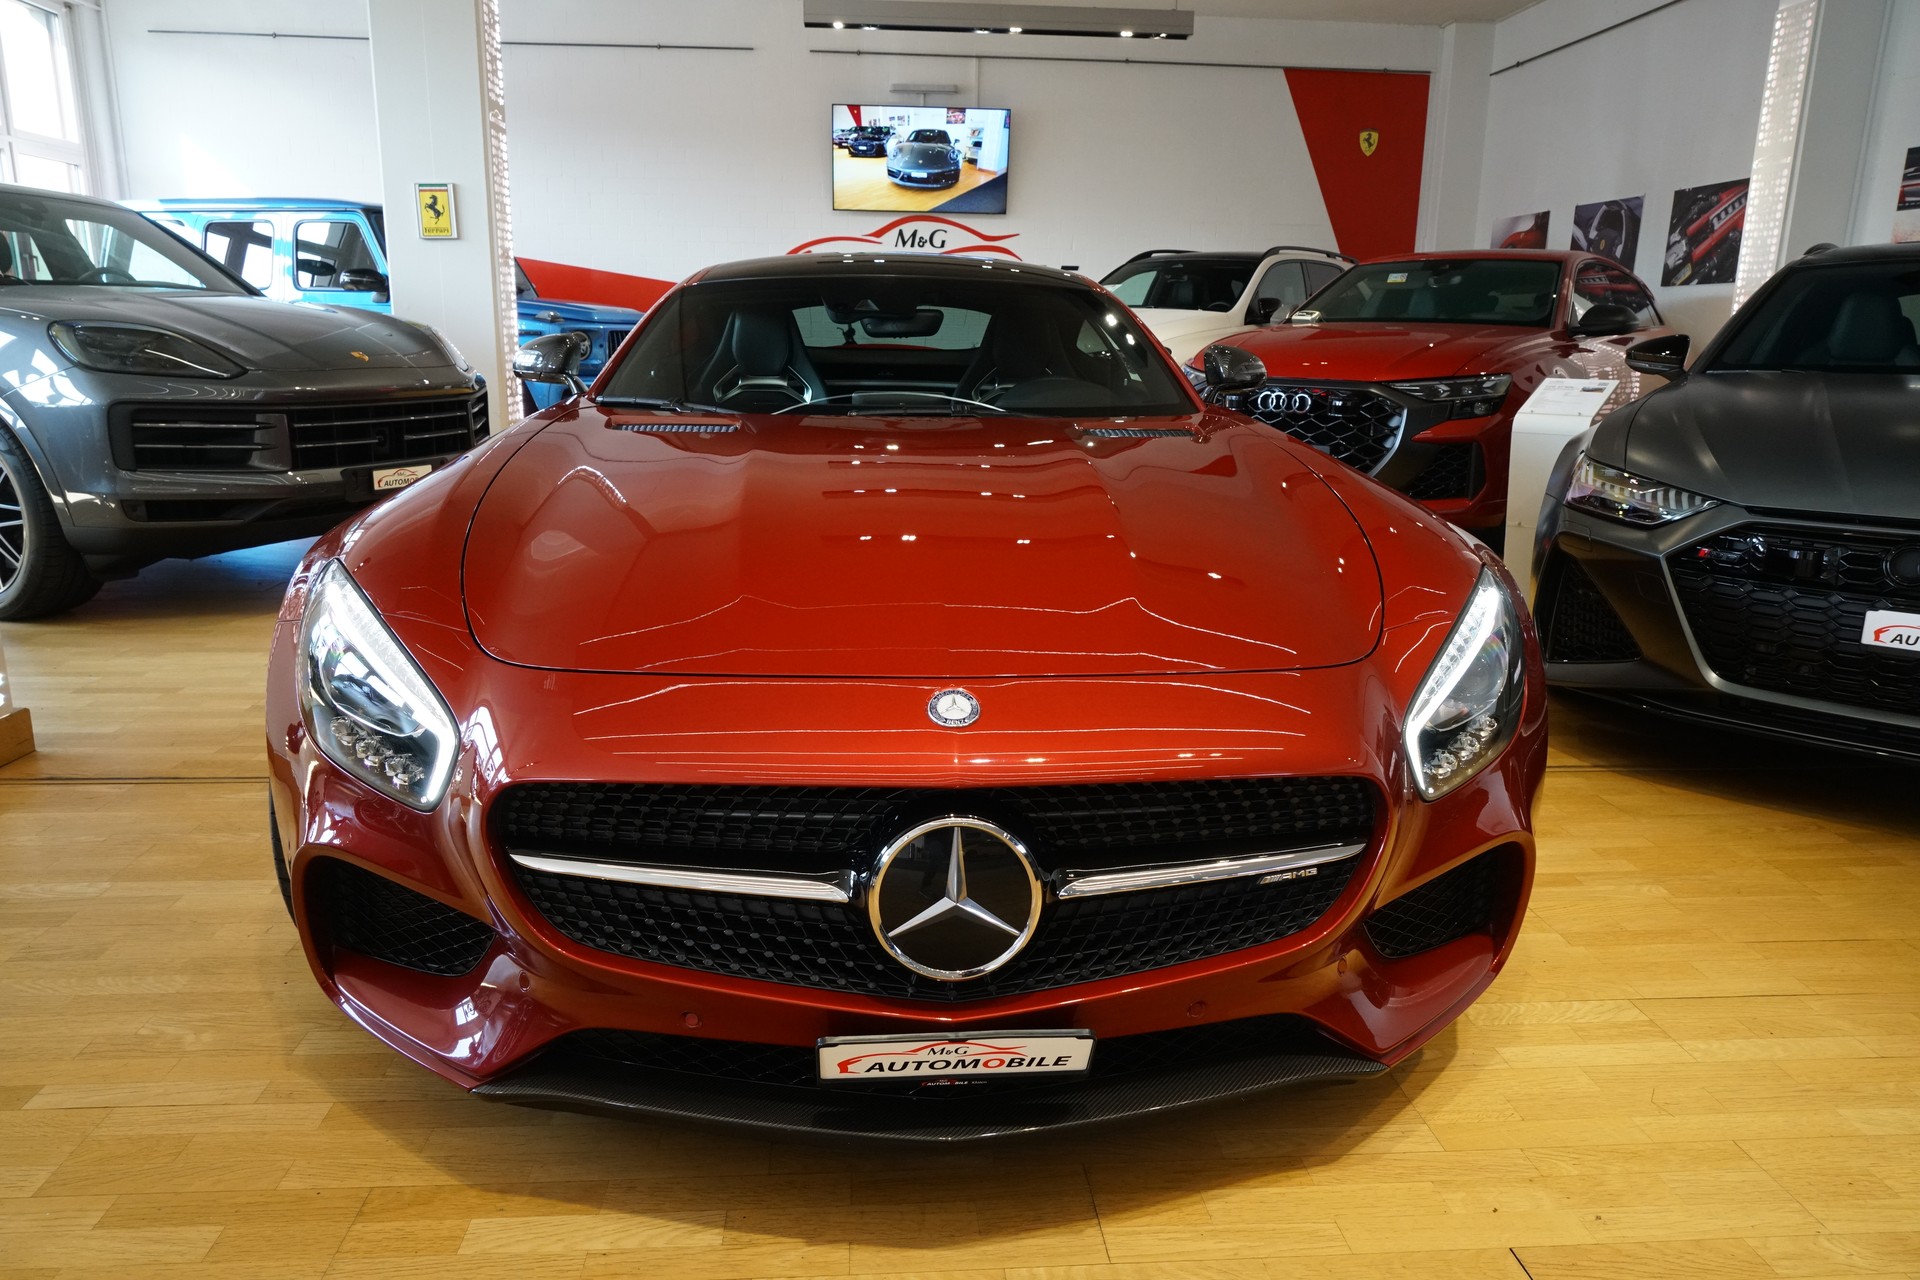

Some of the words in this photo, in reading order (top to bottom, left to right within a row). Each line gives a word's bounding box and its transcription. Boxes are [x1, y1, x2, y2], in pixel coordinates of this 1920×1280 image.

[895, 228, 948, 249] M&G
[927, 1045, 970, 1056] M&G
[864, 1055, 1073, 1073] AUTOMOBILE
